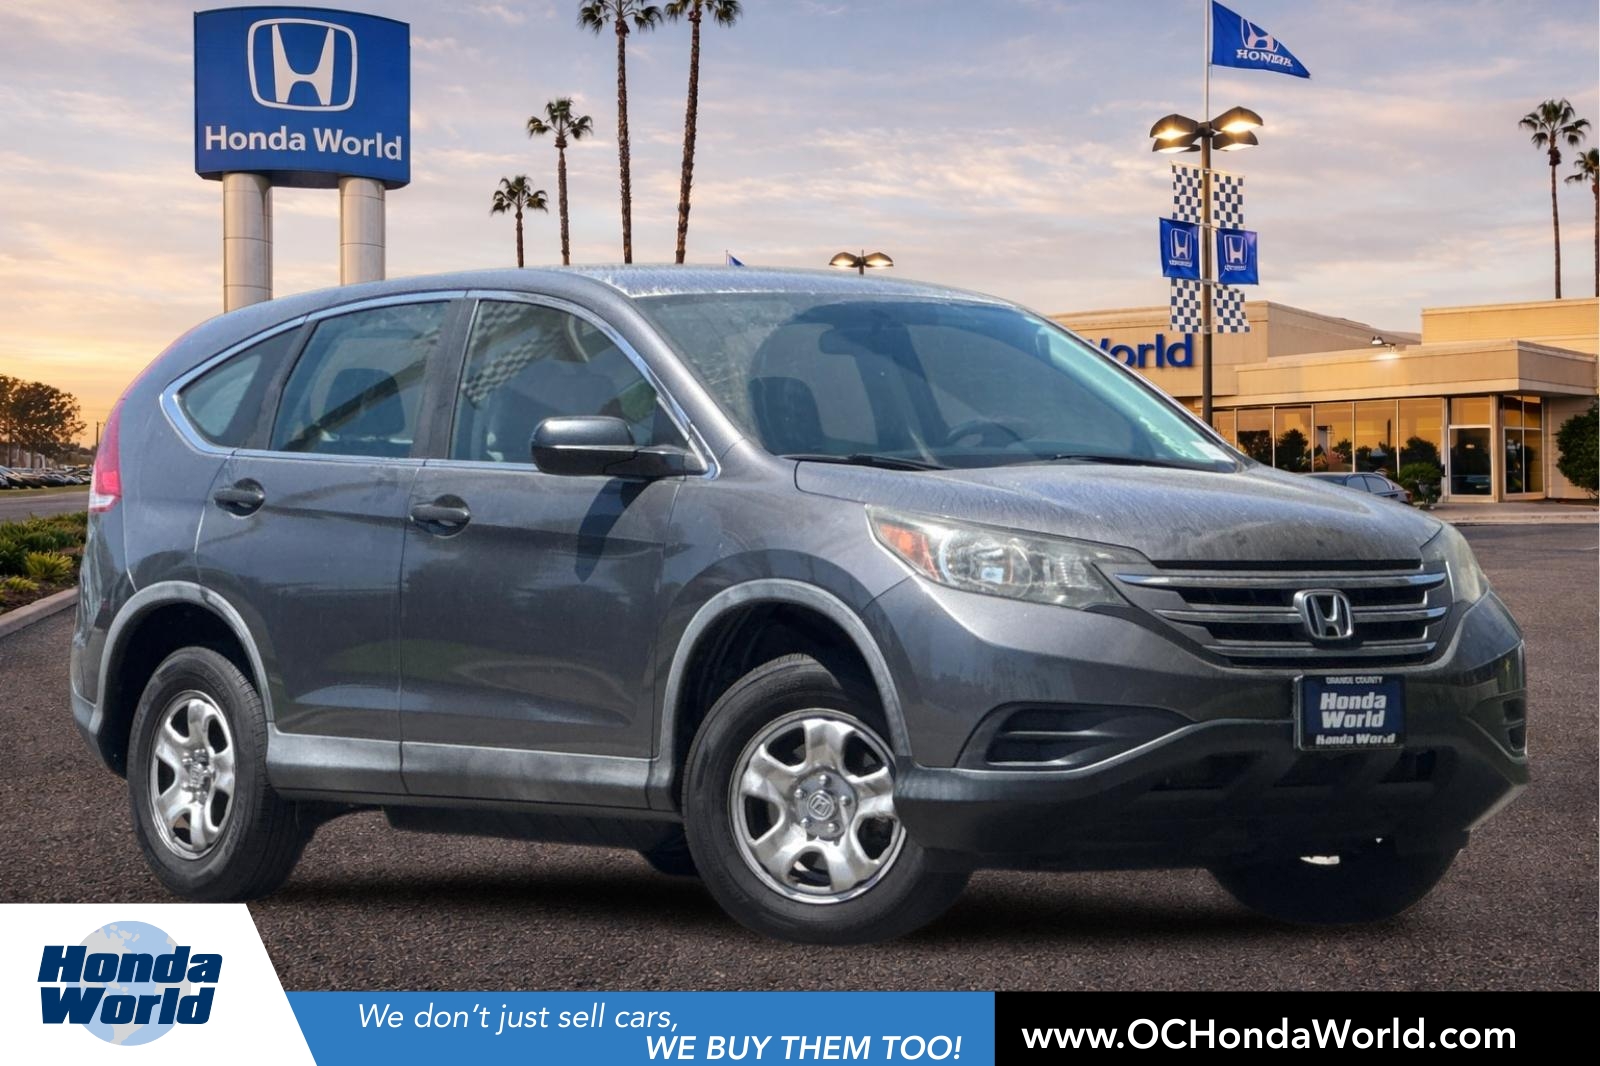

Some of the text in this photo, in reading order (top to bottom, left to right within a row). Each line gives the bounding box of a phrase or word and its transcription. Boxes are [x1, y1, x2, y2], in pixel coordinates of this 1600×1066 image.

[205, 125, 402, 161] Honda World
[1088, 333, 1193, 368] orld
[1320, 692, 1387, 711] Honda
[1322, 710, 1385, 729] World
